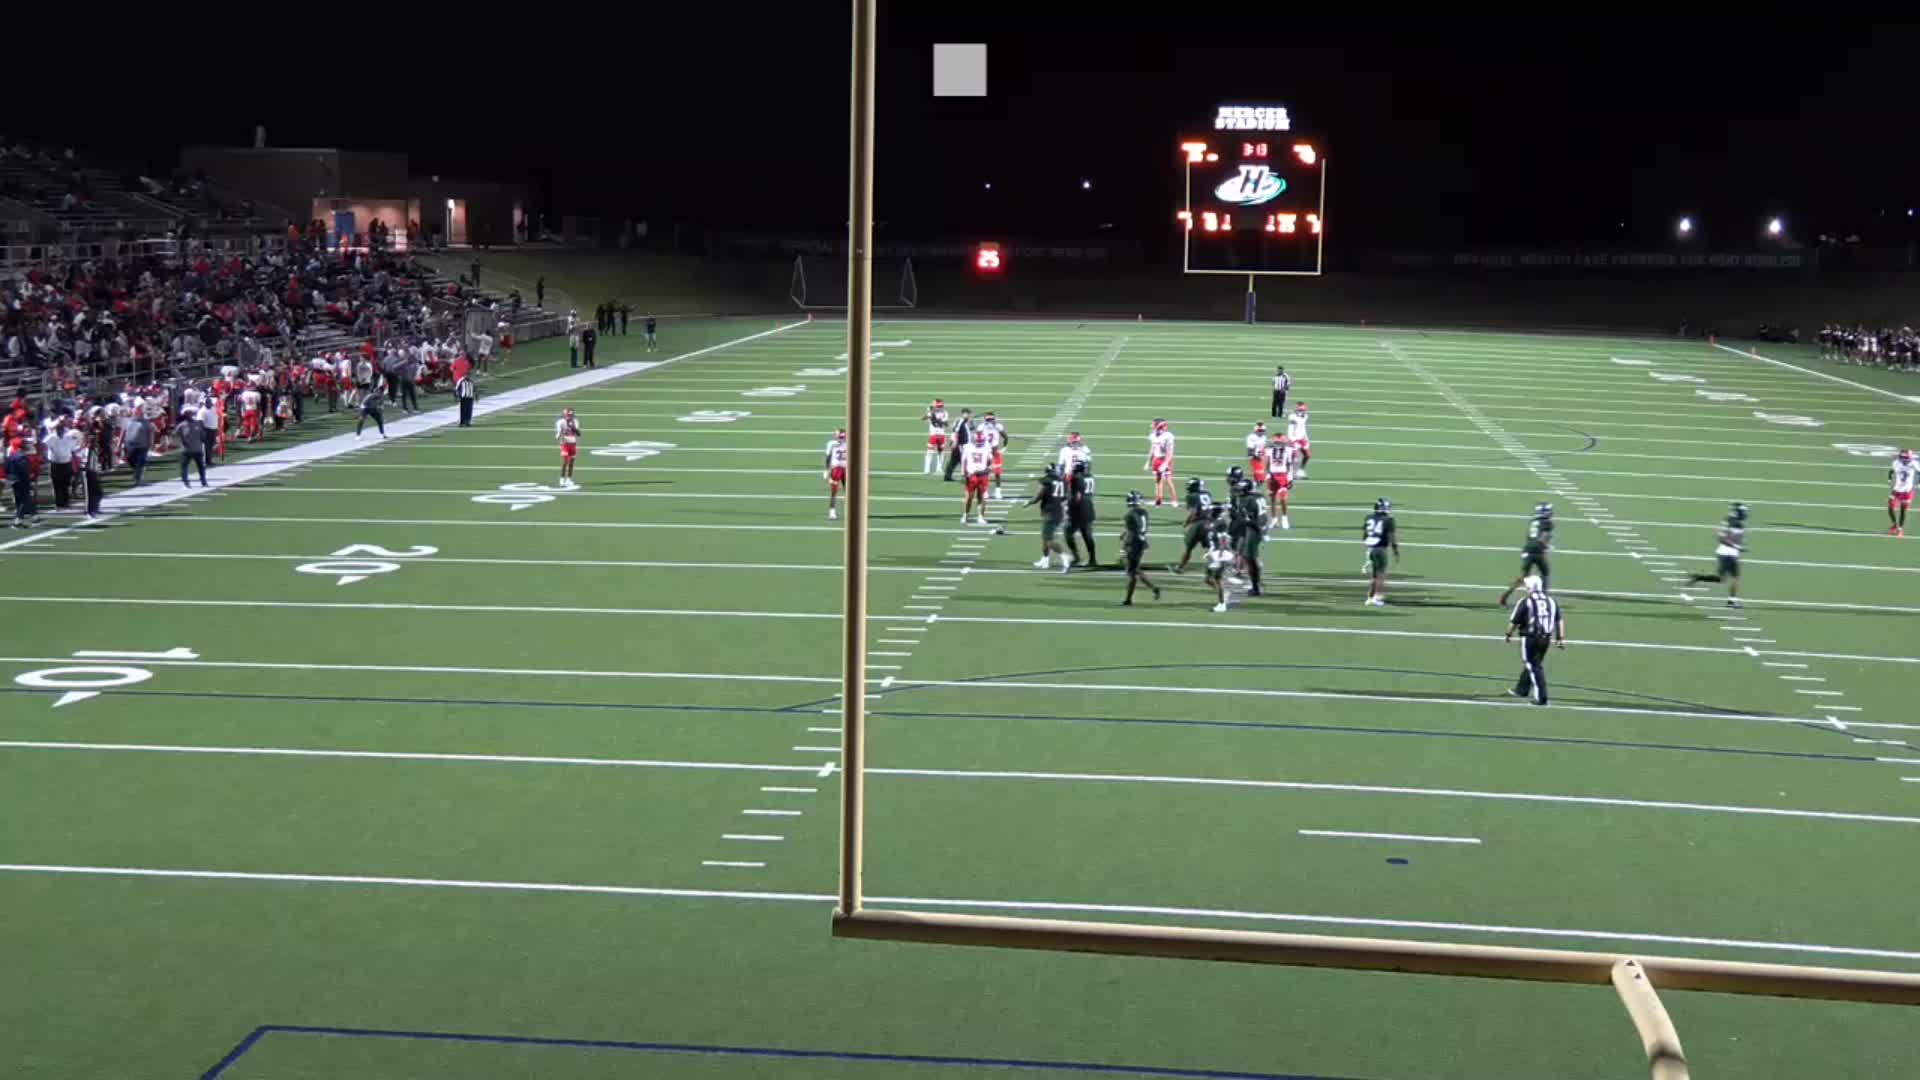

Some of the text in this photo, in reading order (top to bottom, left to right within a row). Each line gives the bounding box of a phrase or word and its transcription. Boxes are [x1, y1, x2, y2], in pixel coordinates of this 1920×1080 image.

[1215, 118, 1290, 130] STADIUM
[471, 482, 582, 504] 30
[1366, 519, 1383, 535] 24
[295, 543, 439, 574] 20
[1537, 600, 1548, 616] R
[14, 647, 201, 688] 10
